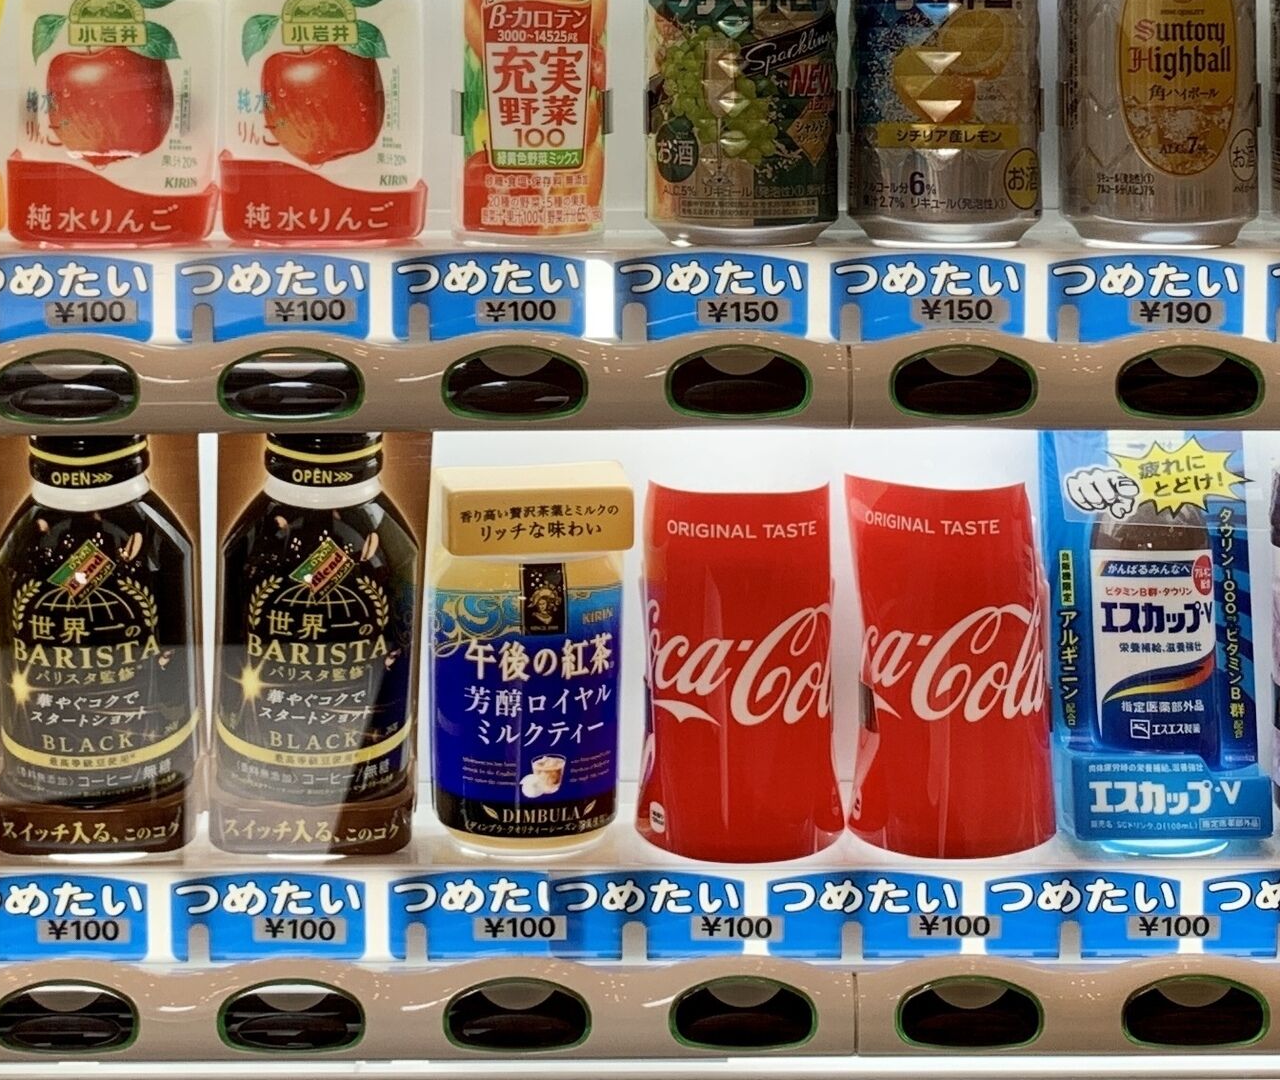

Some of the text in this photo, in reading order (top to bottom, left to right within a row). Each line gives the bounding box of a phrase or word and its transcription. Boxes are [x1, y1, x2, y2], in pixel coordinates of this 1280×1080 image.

[489, 4, 589, 30] β-カロテン
[77, 25, 139, 44] 小岩井
[290, 24, 351, 43] 小岩井
[1134, 18, 1226, 48] Suntory
[491, 46, 585, 95] 充実
[1127, 46, 1232, 81] Highball
[1149, 84, 1220, 102] 角ハイボール
[498, 94, 578, 127] 野菜
[514, 128, 566, 149] 100
[896, 128, 1003, 145] シチリア産レモン
[496, 150, 581, 167] 緑黄色野菜ミックス
[164, 176, 198, 190] KIRIN
[379, 174, 409, 187] KIRIN
[26, 200, 180, 234] 純水りんご
[244, 200, 395, 233] 純水りんご
[55, 300, 127, 323] ¥100
[275, 297, 346, 322] ¥100
[486, 298, 558, 322] ¥100
[707, 298, 780, 323] ¥150
[921, 298, 993, 321] ¥150
[1139, 300, 1213, 324] ¥190
[460, 504, 619, 524] 香り高い贅沢茶葉とミルクの
[864, 510, 1001, 535] ORIGINAL TASTE
[480, 522, 603, 543] リッチな味わい
[666, 519, 818, 538] ORIGINAL TASTE
[1107, 562, 1191, 576] がんばるみんなへ
[1105, 586, 1193, 598] ビタミンB群・タウリン
[13, 634, 161, 669] BARISTA
[247, 633, 389, 667] BARISTA
[464, 632, 613, 682] 午後の紅茶
[1119, 641, 1203, 654] 栄養補給、滋養強壮
[36, 667, 136, 685] バリスタ監修
[268, 665, 365, 683] バリスタ監修
[36, 690, 140, 709] 華やぐコクで
[266, 687, 368, 707] 華やぐコクで
[464, 683, 612, 718] 芳醇ロイヤル
[1121, 700, 1205, 714] 指定医薬部外品
[30, 706, 147, 726] スタートショット
[258, 705, 373, 726] スタートショット
[269, 729, 362, 749] BLACK
[477, 720, 605, 748] ミルクティー
[1151, 722, 1202, 736] エスエス製薬
[42, 732, 135, 753] BLACK
[1089, 779, 1242, 815] エスカップ・V
[502, 805, 583, 824] DIMBULA
[2, 819, 181, 847] スイッチ入る、このコク
[223, 818, 401, 844] スイッチ入る、このコク
[47, 919, 121, 942] ¥100
[264, 917, 337, 941] ¥100
[484, 916, 557, 939] ¥100
[700, 915, 773, 939] ¥100
[919, 912, 992, 938] ¥100
[1138, 914, 1211, 938] ¥100
